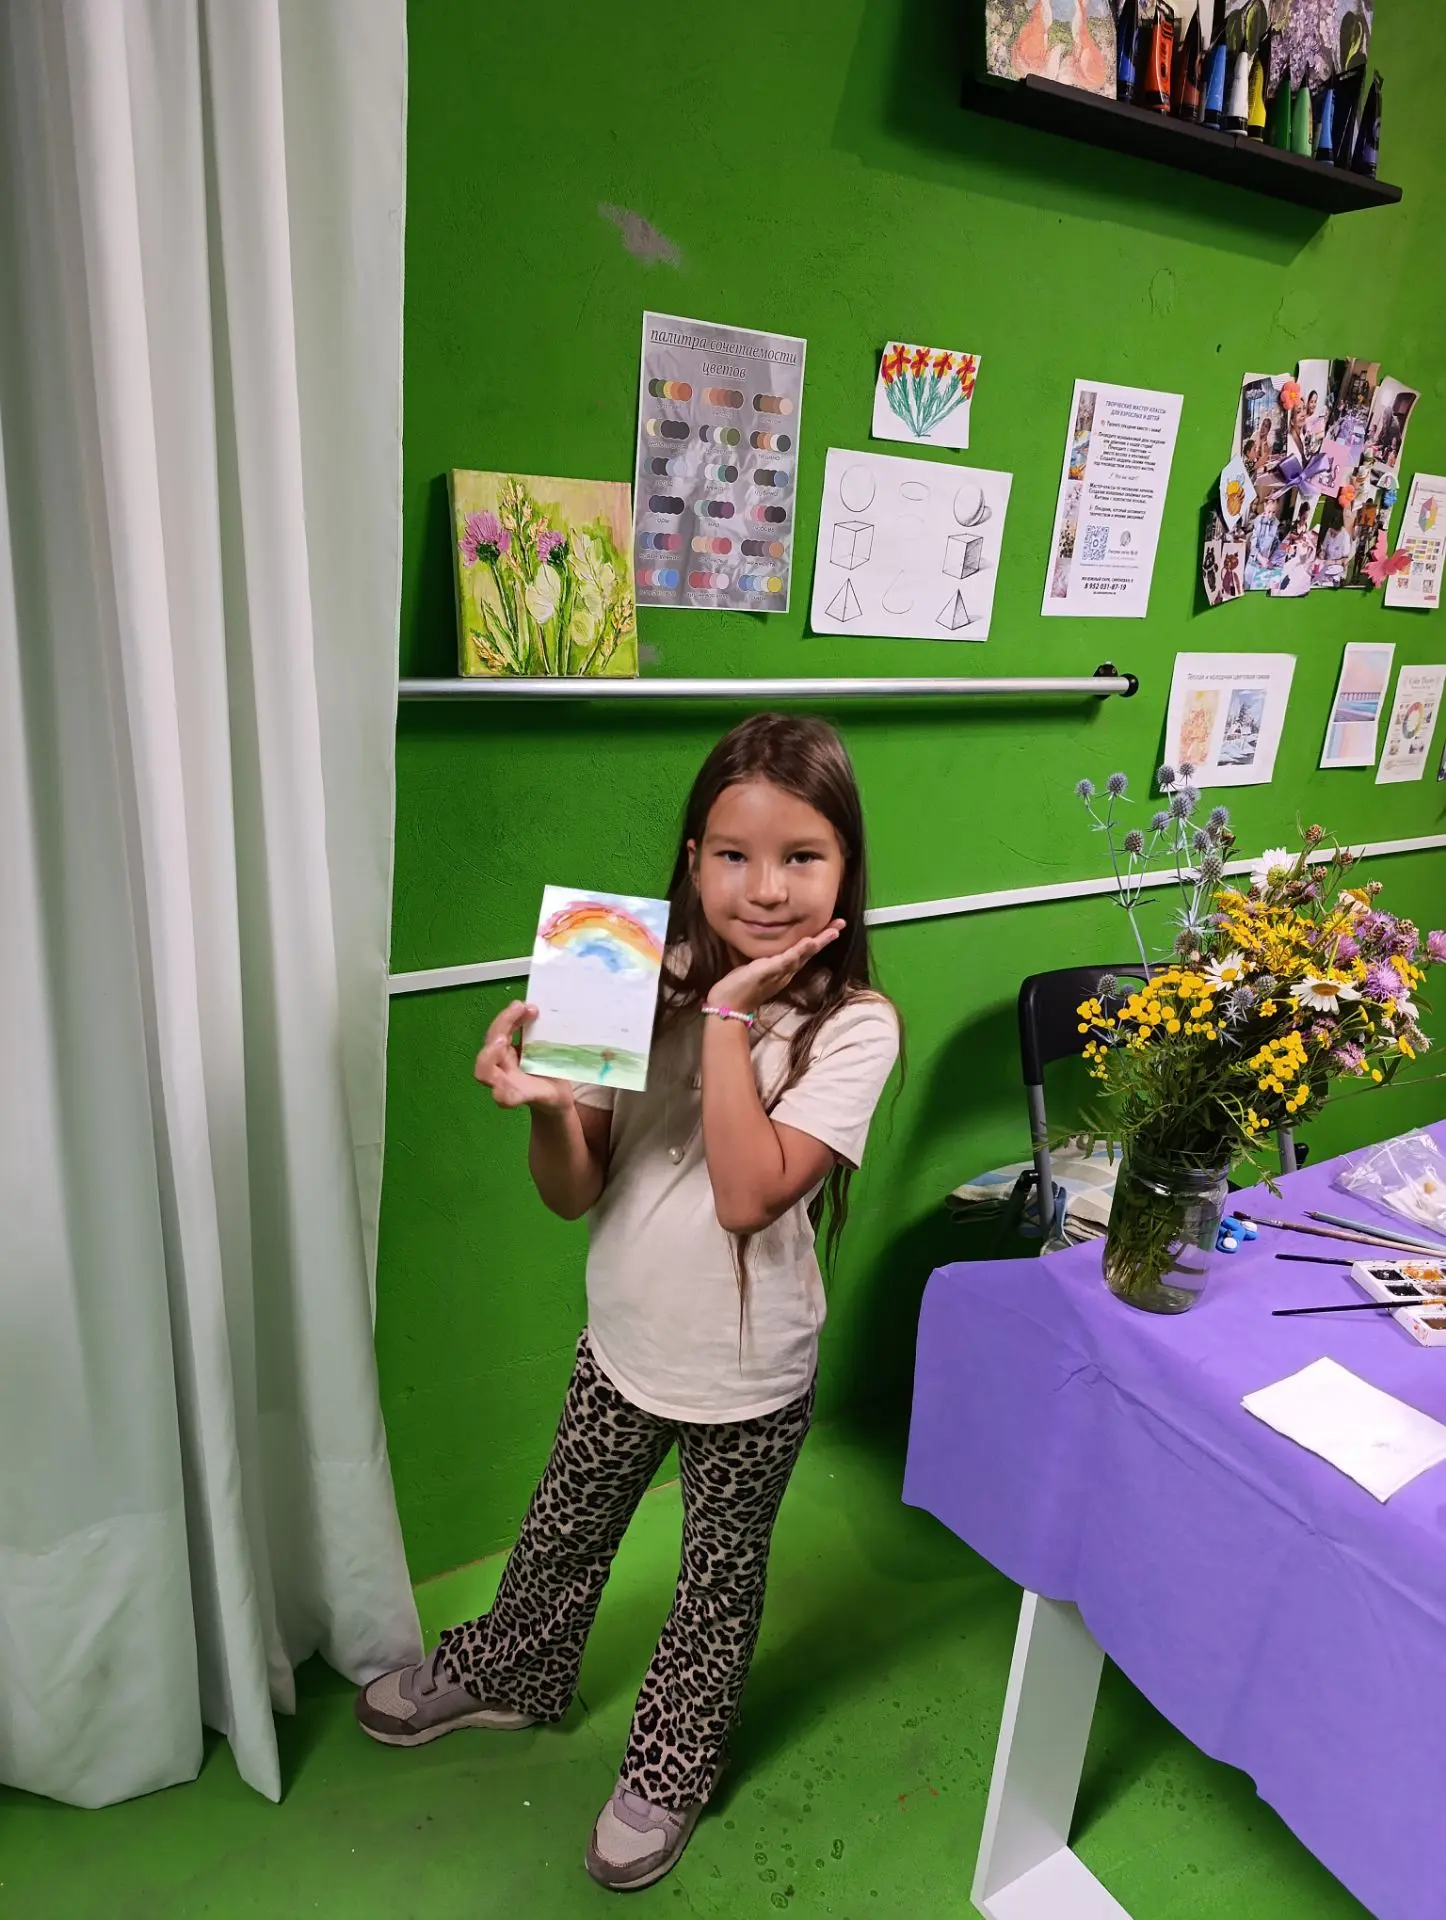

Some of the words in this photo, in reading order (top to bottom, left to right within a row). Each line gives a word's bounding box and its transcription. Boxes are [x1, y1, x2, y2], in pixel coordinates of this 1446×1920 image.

[650, 328, 707, 350] палитра
[710, 339, 797, 364] сочетаемости
[702, 361, 747, 379] цветов
